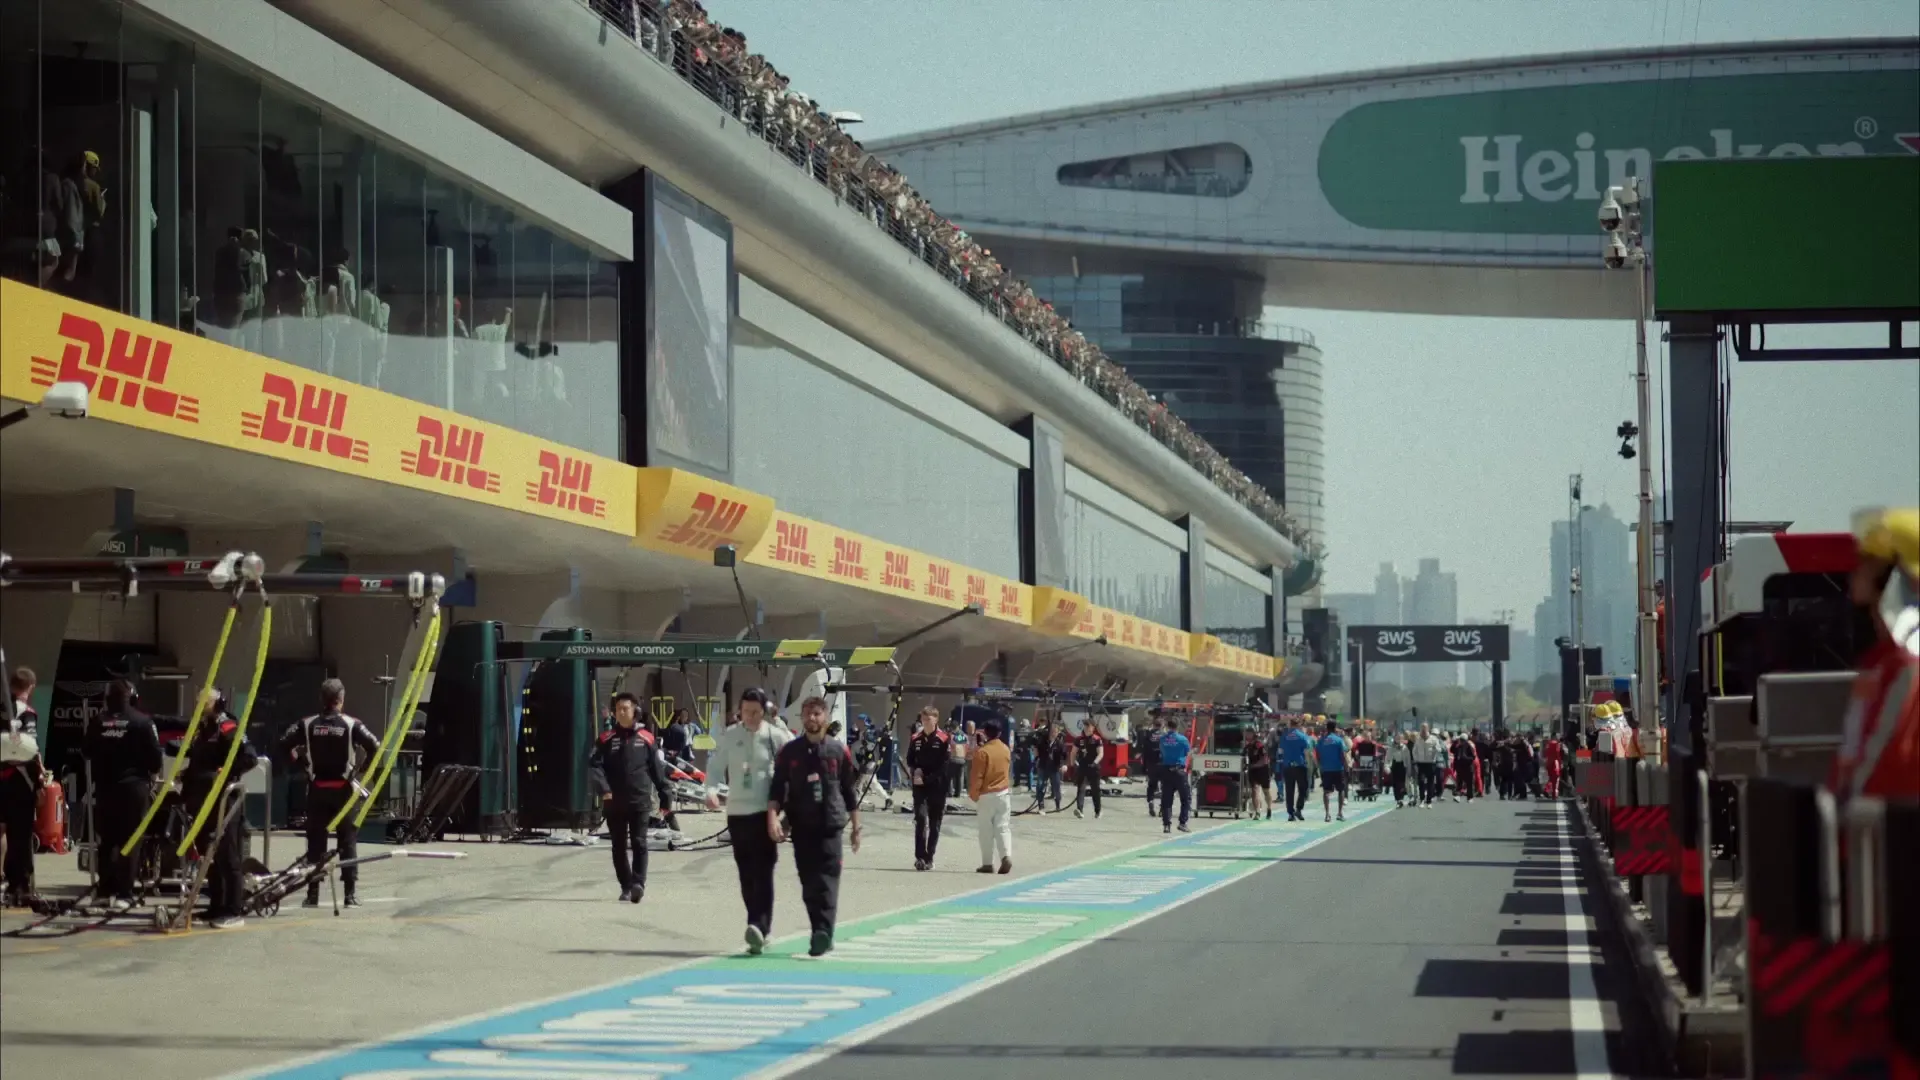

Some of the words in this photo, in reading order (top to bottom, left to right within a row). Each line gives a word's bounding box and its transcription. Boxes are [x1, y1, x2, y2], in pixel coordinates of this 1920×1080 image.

[57, 312, 179, 417] DHL
[260, 373, 354, 460] DHL
[416, 416, 488, 491] DHL
[538, 450, 596, 516] DHL
[776, 520, 811, 568] DHL
[833, 537, 864, 580] DHL
[885, 551, 911, 591] DHL
[928, 563, 952, 601] DHL
[1000, 584, 1019, 617] DHL
[566, 645, 595, 655] ASTON
[596, 645, 630, 655] MARTIN
[633, 645, 675, 655] aramco
[736, 645, 760, 655] arm
[1377, 630, 1415, 645] aws
[1444, 630, 1481, 645] aws
